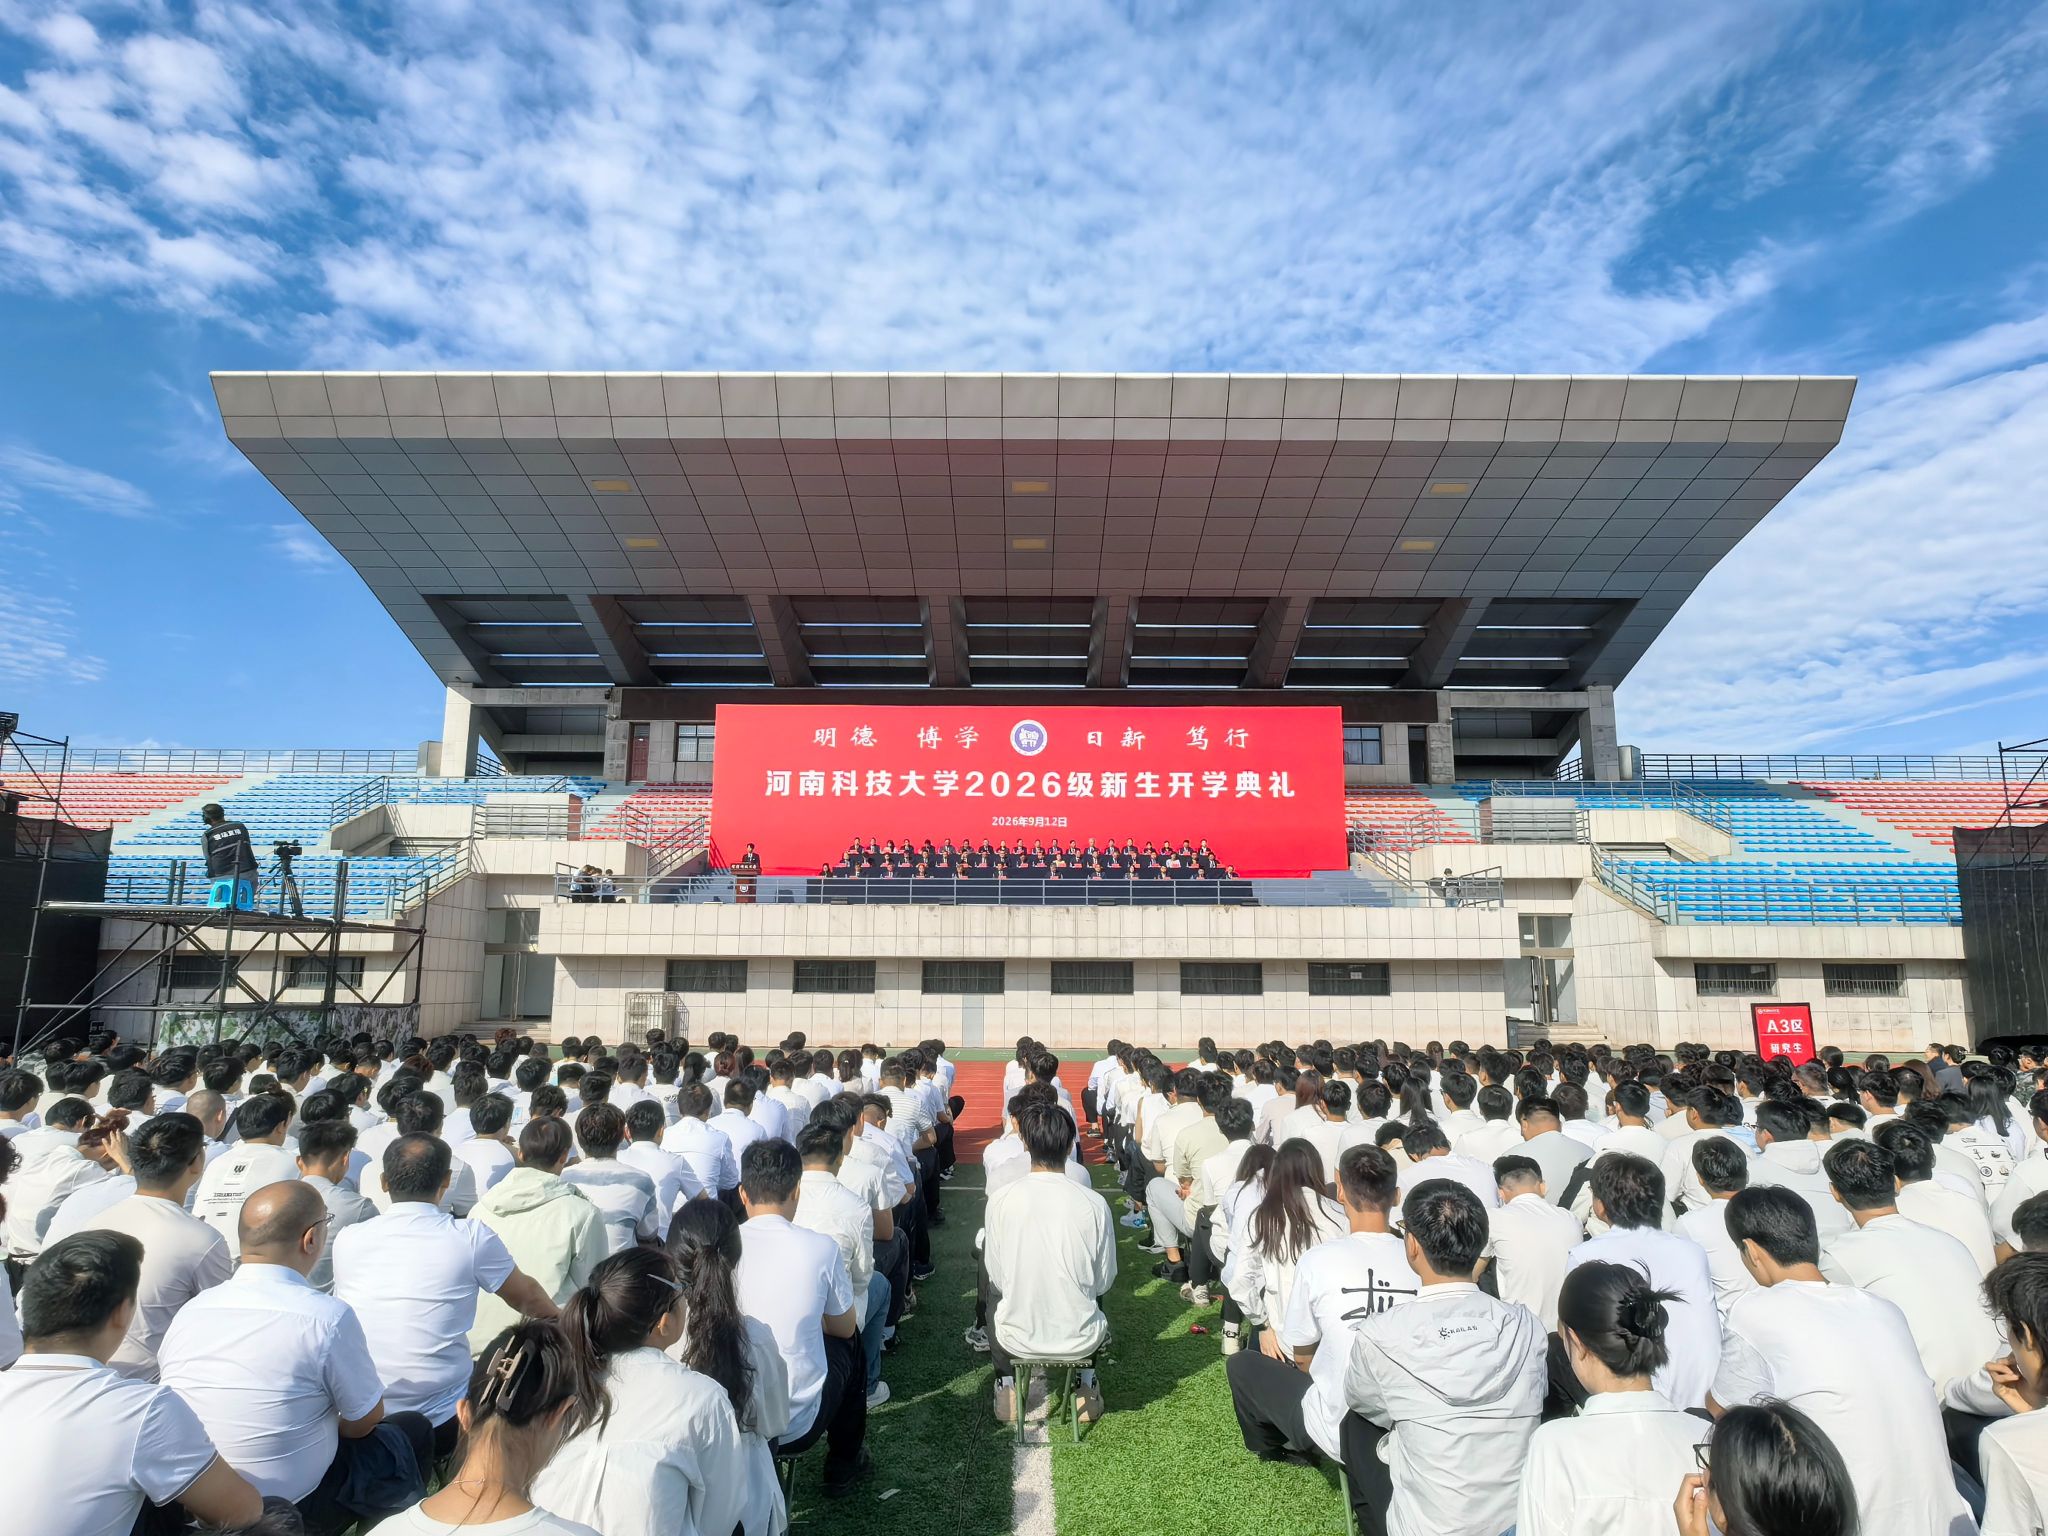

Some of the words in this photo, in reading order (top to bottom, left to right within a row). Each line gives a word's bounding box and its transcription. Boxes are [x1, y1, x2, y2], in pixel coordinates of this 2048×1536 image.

[812, 724, 878, 748] 明德
[916, 725, 979, 750] 博学
[1087, 726, 1146, 751] 日新
[1186, 725, 1249, 751] 笃行
[764, 769, 1295, 799] 河南科技大学2026级新生开学典礼
[991, 815, 1068, 828] 2026年9月12日
[1767, 1018, 1804, 1033] A3区
